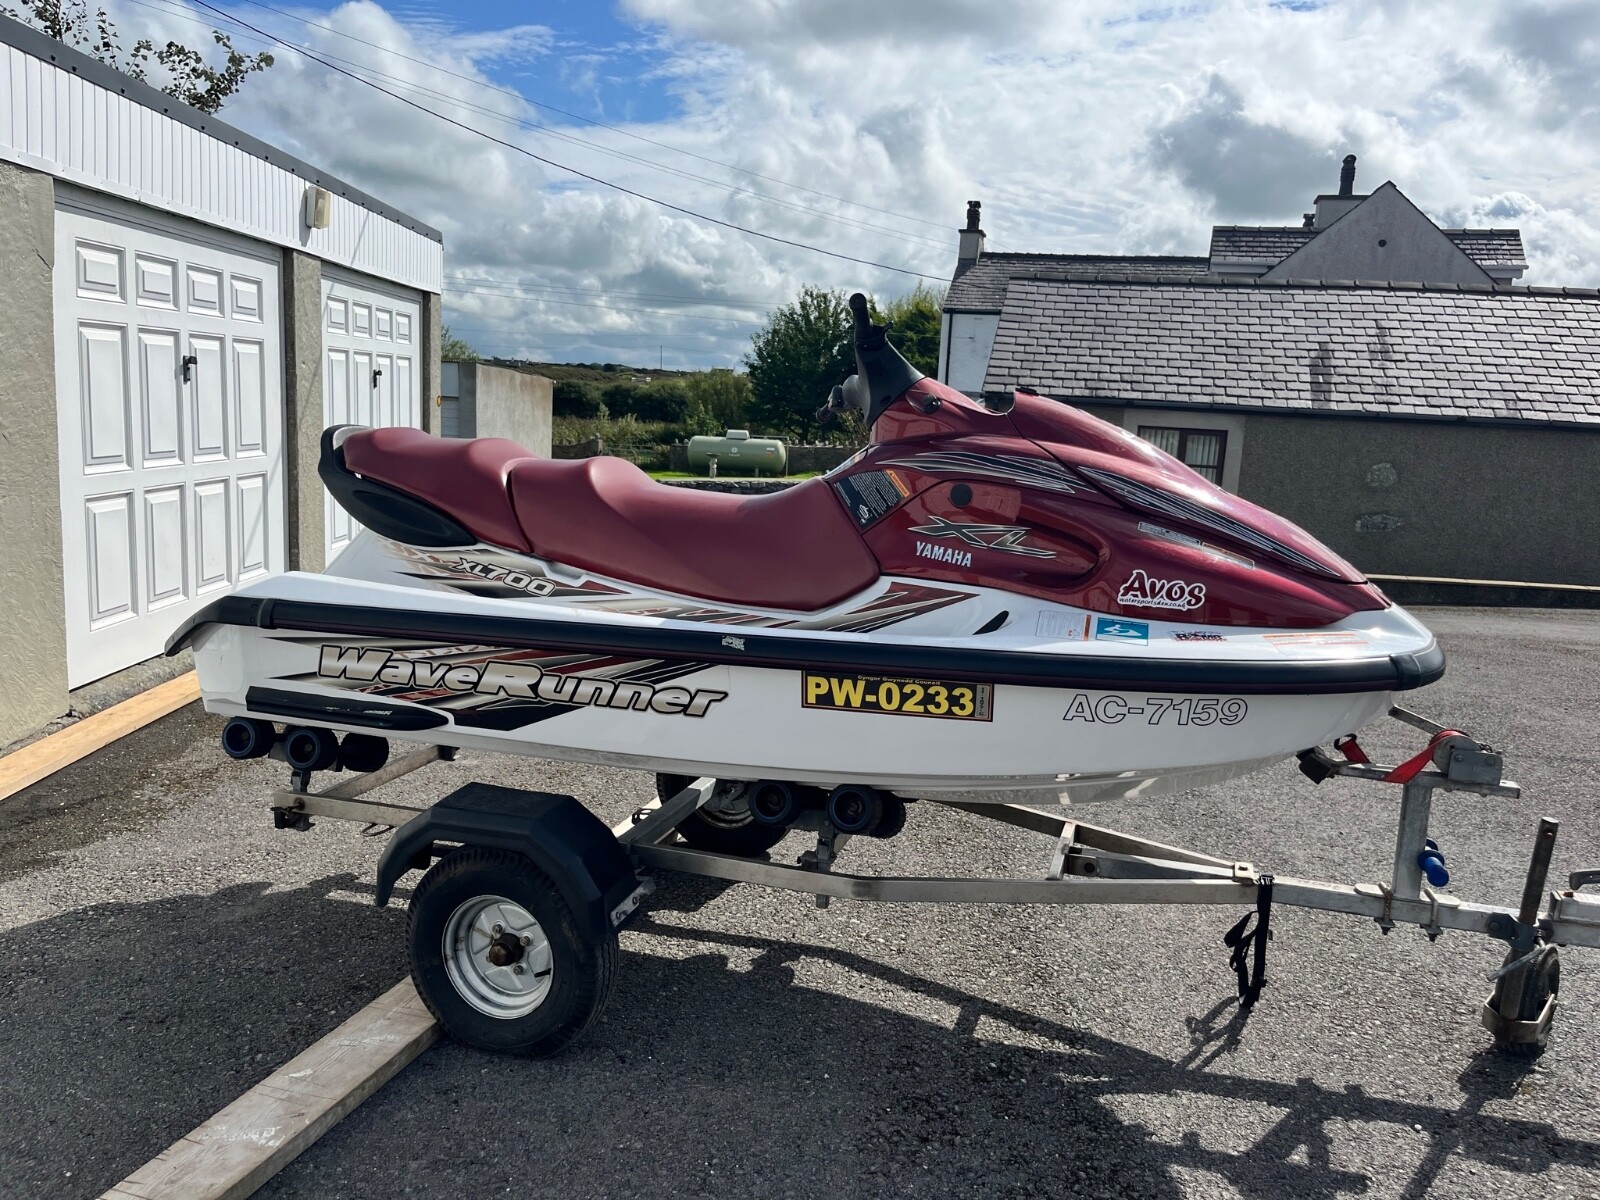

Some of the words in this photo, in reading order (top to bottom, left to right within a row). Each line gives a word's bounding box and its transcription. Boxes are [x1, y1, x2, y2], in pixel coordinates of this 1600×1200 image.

[908, 516, 1056, 559] XL
[916, 541, 972, 567] YAMAHA
[455, 557, 556, 597] XL700
[318, 644, 729, 718] WaveRunner
[807, 675, 975, 716] PW-0233
[882, 676, 913, 684] Gwynedd
[1063, 693, 1248, 726] AC-7159
